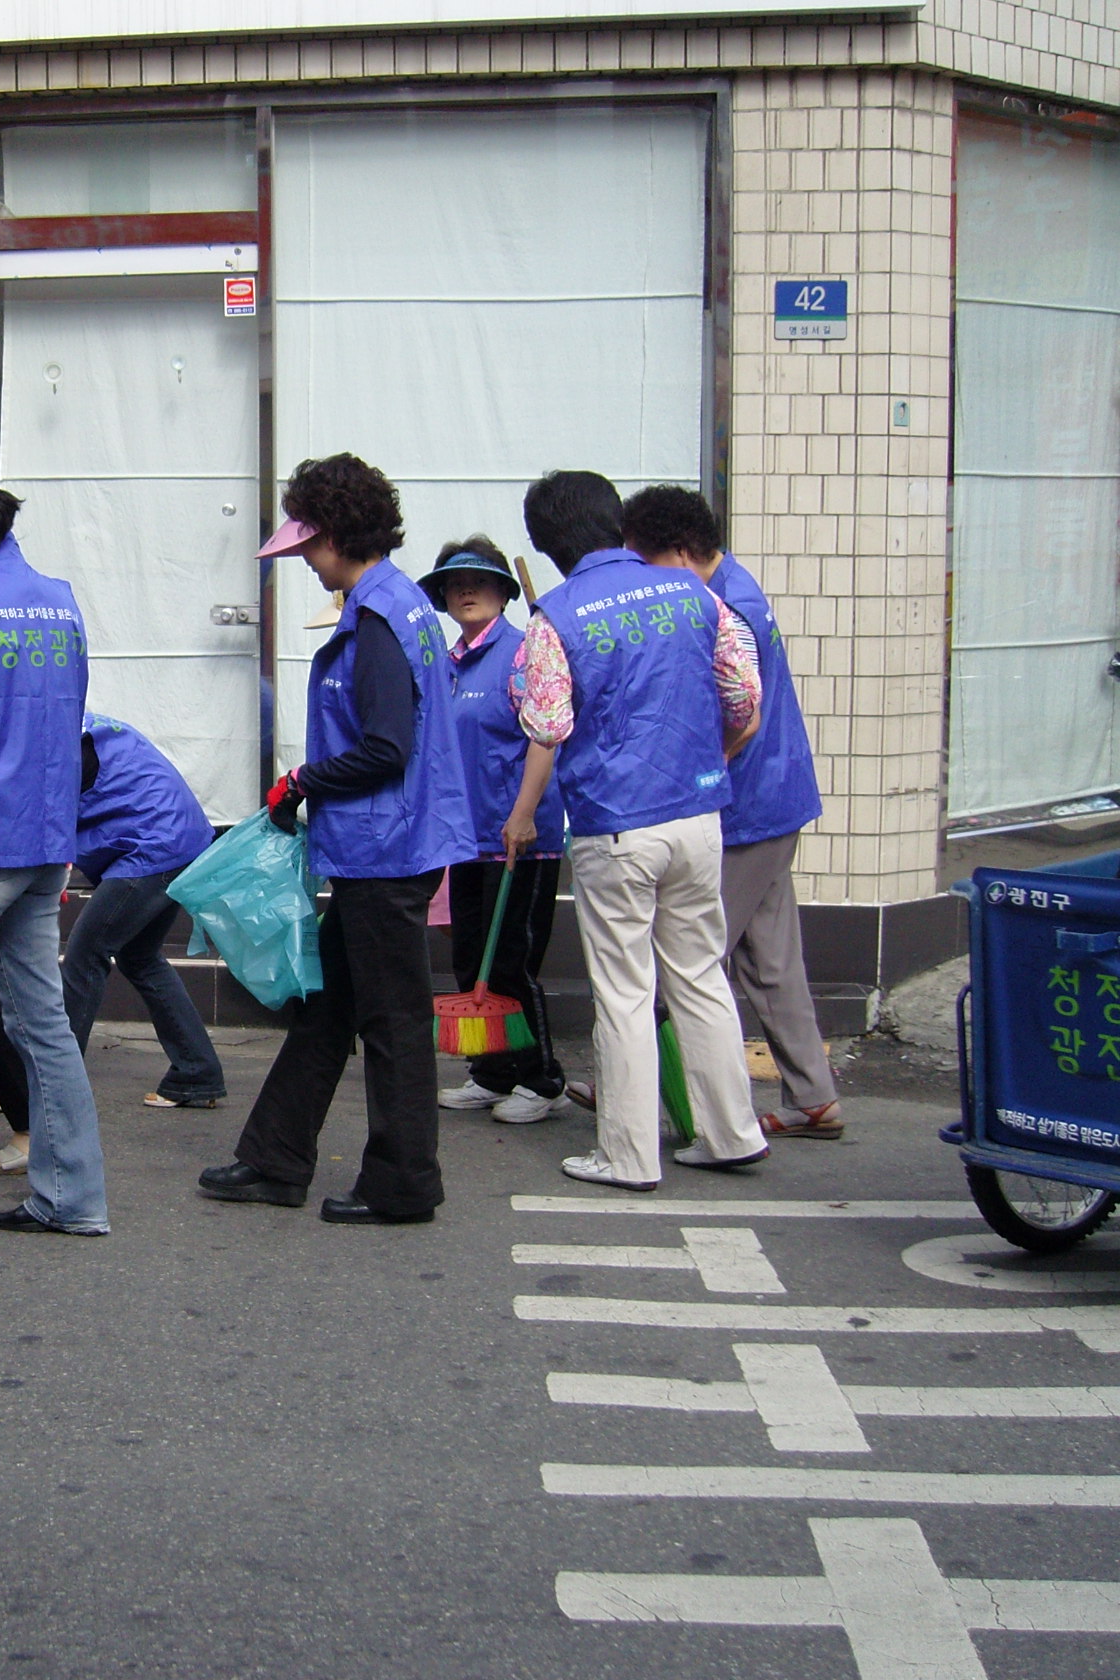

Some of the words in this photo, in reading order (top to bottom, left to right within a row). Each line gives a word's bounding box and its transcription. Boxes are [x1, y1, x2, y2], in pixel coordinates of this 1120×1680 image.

[794, 285, 825, 311] 42
[575, 597, 615, 617] 쾌적하고
[616, 587, 654, 604] 살기좋은
[655, 582, 693, 595] 맑은도시
[26, 606, 56, 620] 살기좋은
[583, 596, 706, 654] 청정광진
[1007, 886, 1071, 911] 광진구
[1037, 1116, 1079, 1142] 살기좋은
